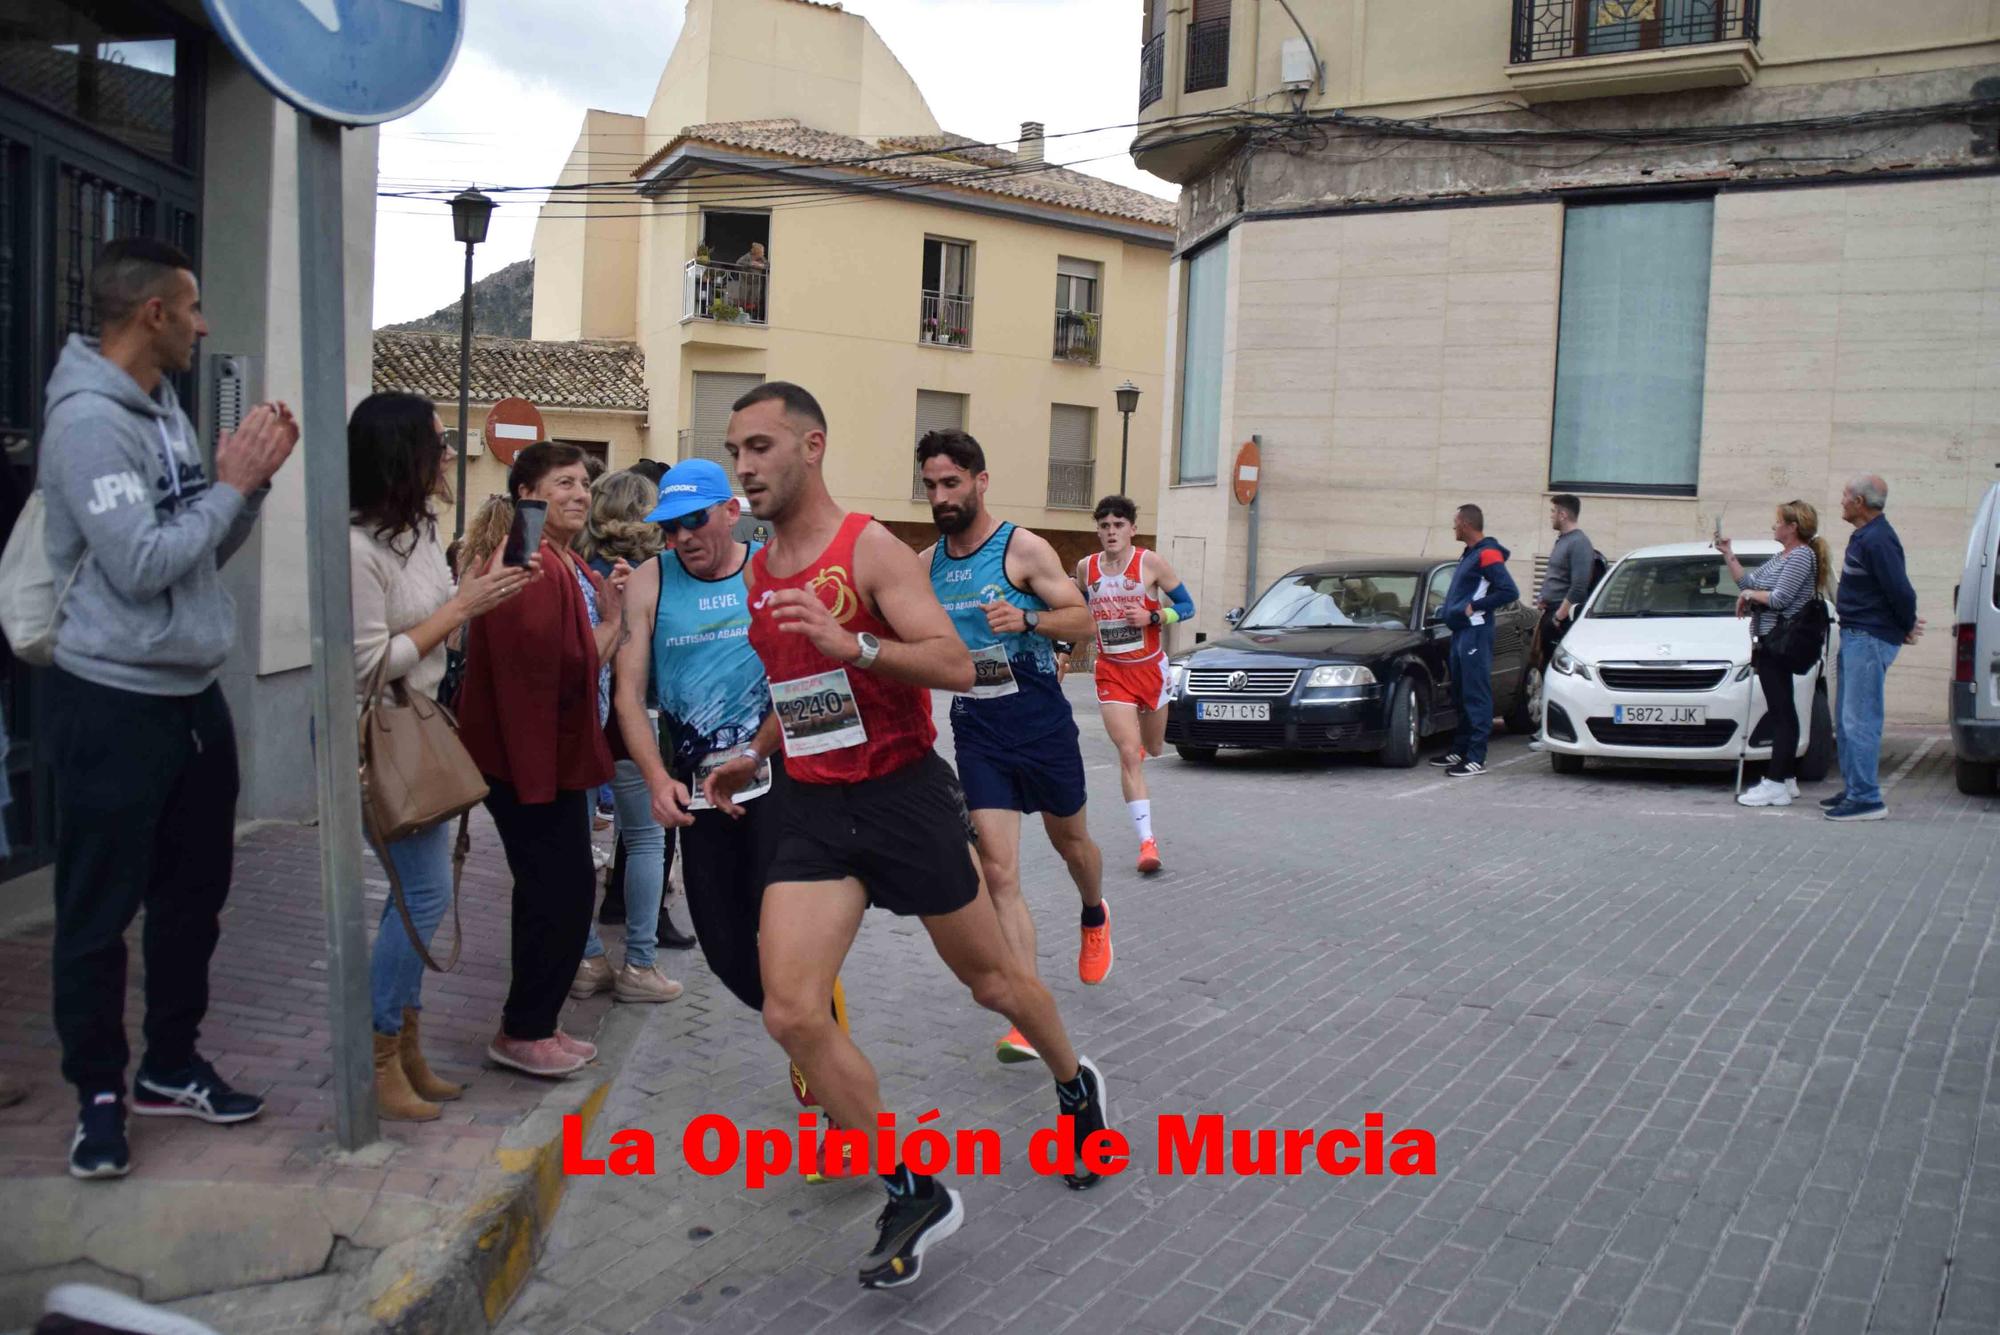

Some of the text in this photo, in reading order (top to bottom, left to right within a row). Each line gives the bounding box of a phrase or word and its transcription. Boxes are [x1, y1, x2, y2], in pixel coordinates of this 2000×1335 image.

[87, 471, 146, 515] JPN
[717, 627, 749, 640] ABARA
[1205, 705, 1266, 719] 4371 CYS
[1626, 707, 1697, 721] 5872 JJK
